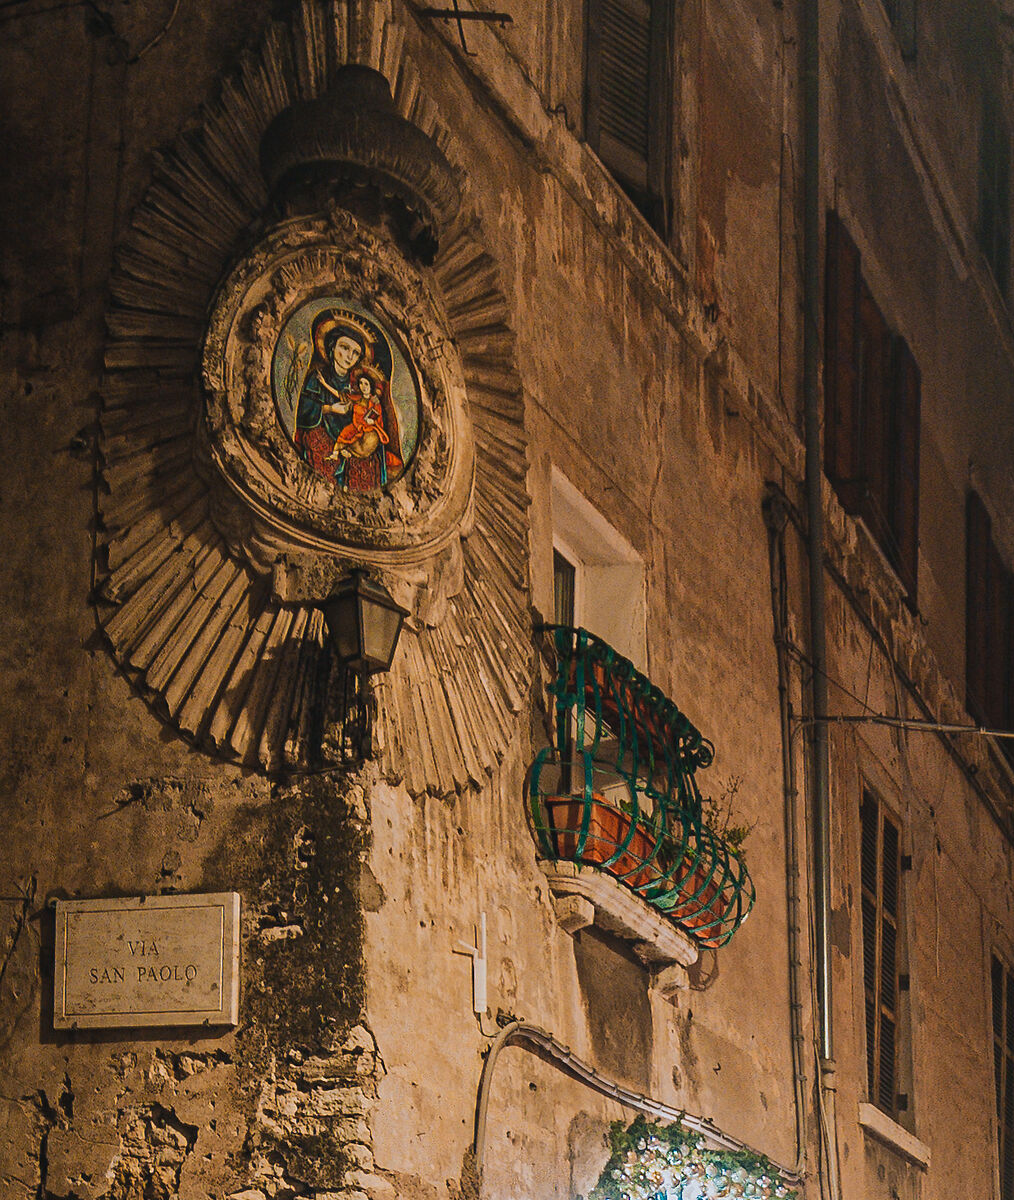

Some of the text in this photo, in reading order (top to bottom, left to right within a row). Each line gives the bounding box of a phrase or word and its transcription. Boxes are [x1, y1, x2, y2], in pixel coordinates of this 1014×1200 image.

[128, 941, 159, 956] VIA
[89, 964, 197, 984] SAN PAOLO
